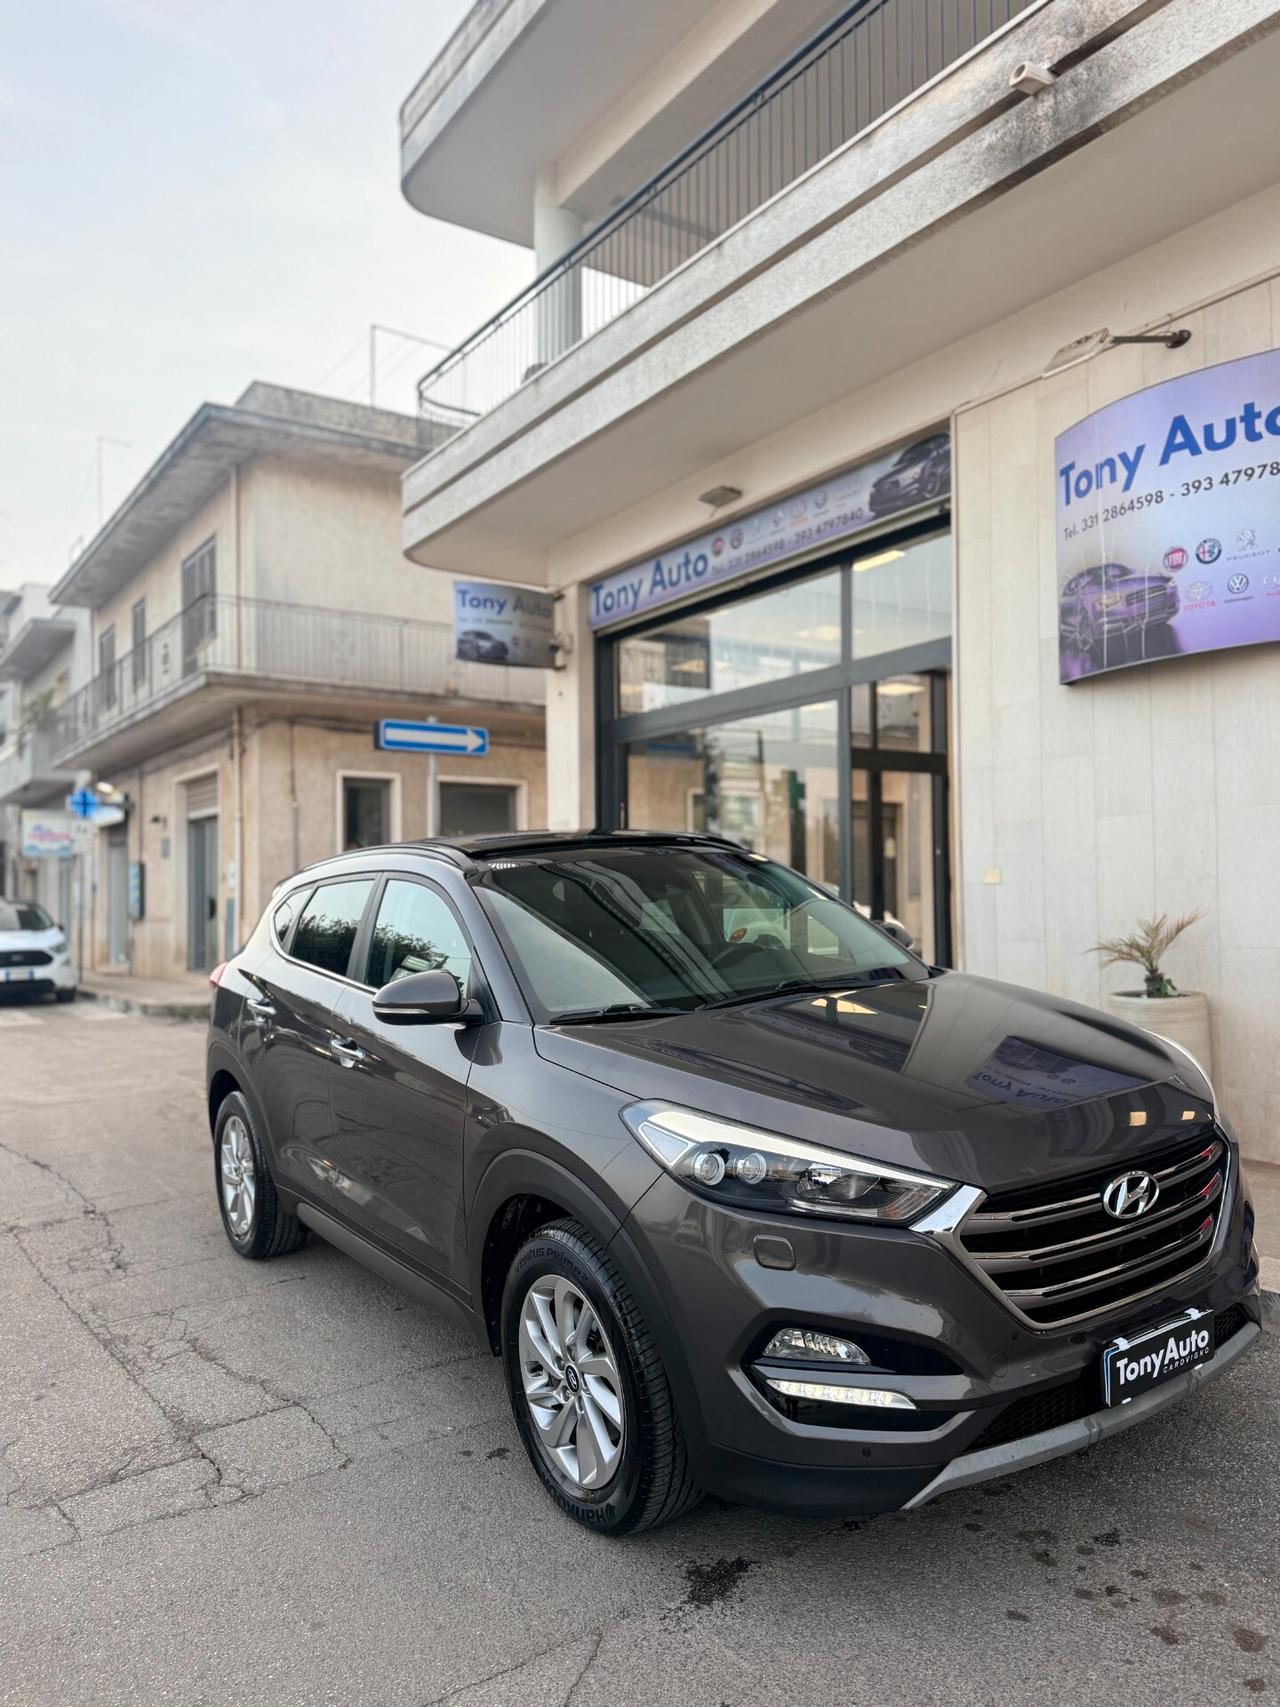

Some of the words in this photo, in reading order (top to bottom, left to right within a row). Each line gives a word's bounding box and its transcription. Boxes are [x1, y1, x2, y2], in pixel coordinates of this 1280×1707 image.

[1059, 443, 1146, 507] Tony
[1082, 513, 1099, 533] 331
[1102, 490, 1164, 523] 2864598
[1181, 475, 1215, 498] 393
[457, 589, 507, 615] Tony
[512, 595, 551, 618] Auto
[591, 579, 643, 617] Tony
[649, 552, 708, 597] Auto
[1183, 600, 1216, 613] TOYOTA
[1115, 1330, 1209, 1386] TonyAuto
[1162, 1347, 1210, 1374] CAROVIGNO
